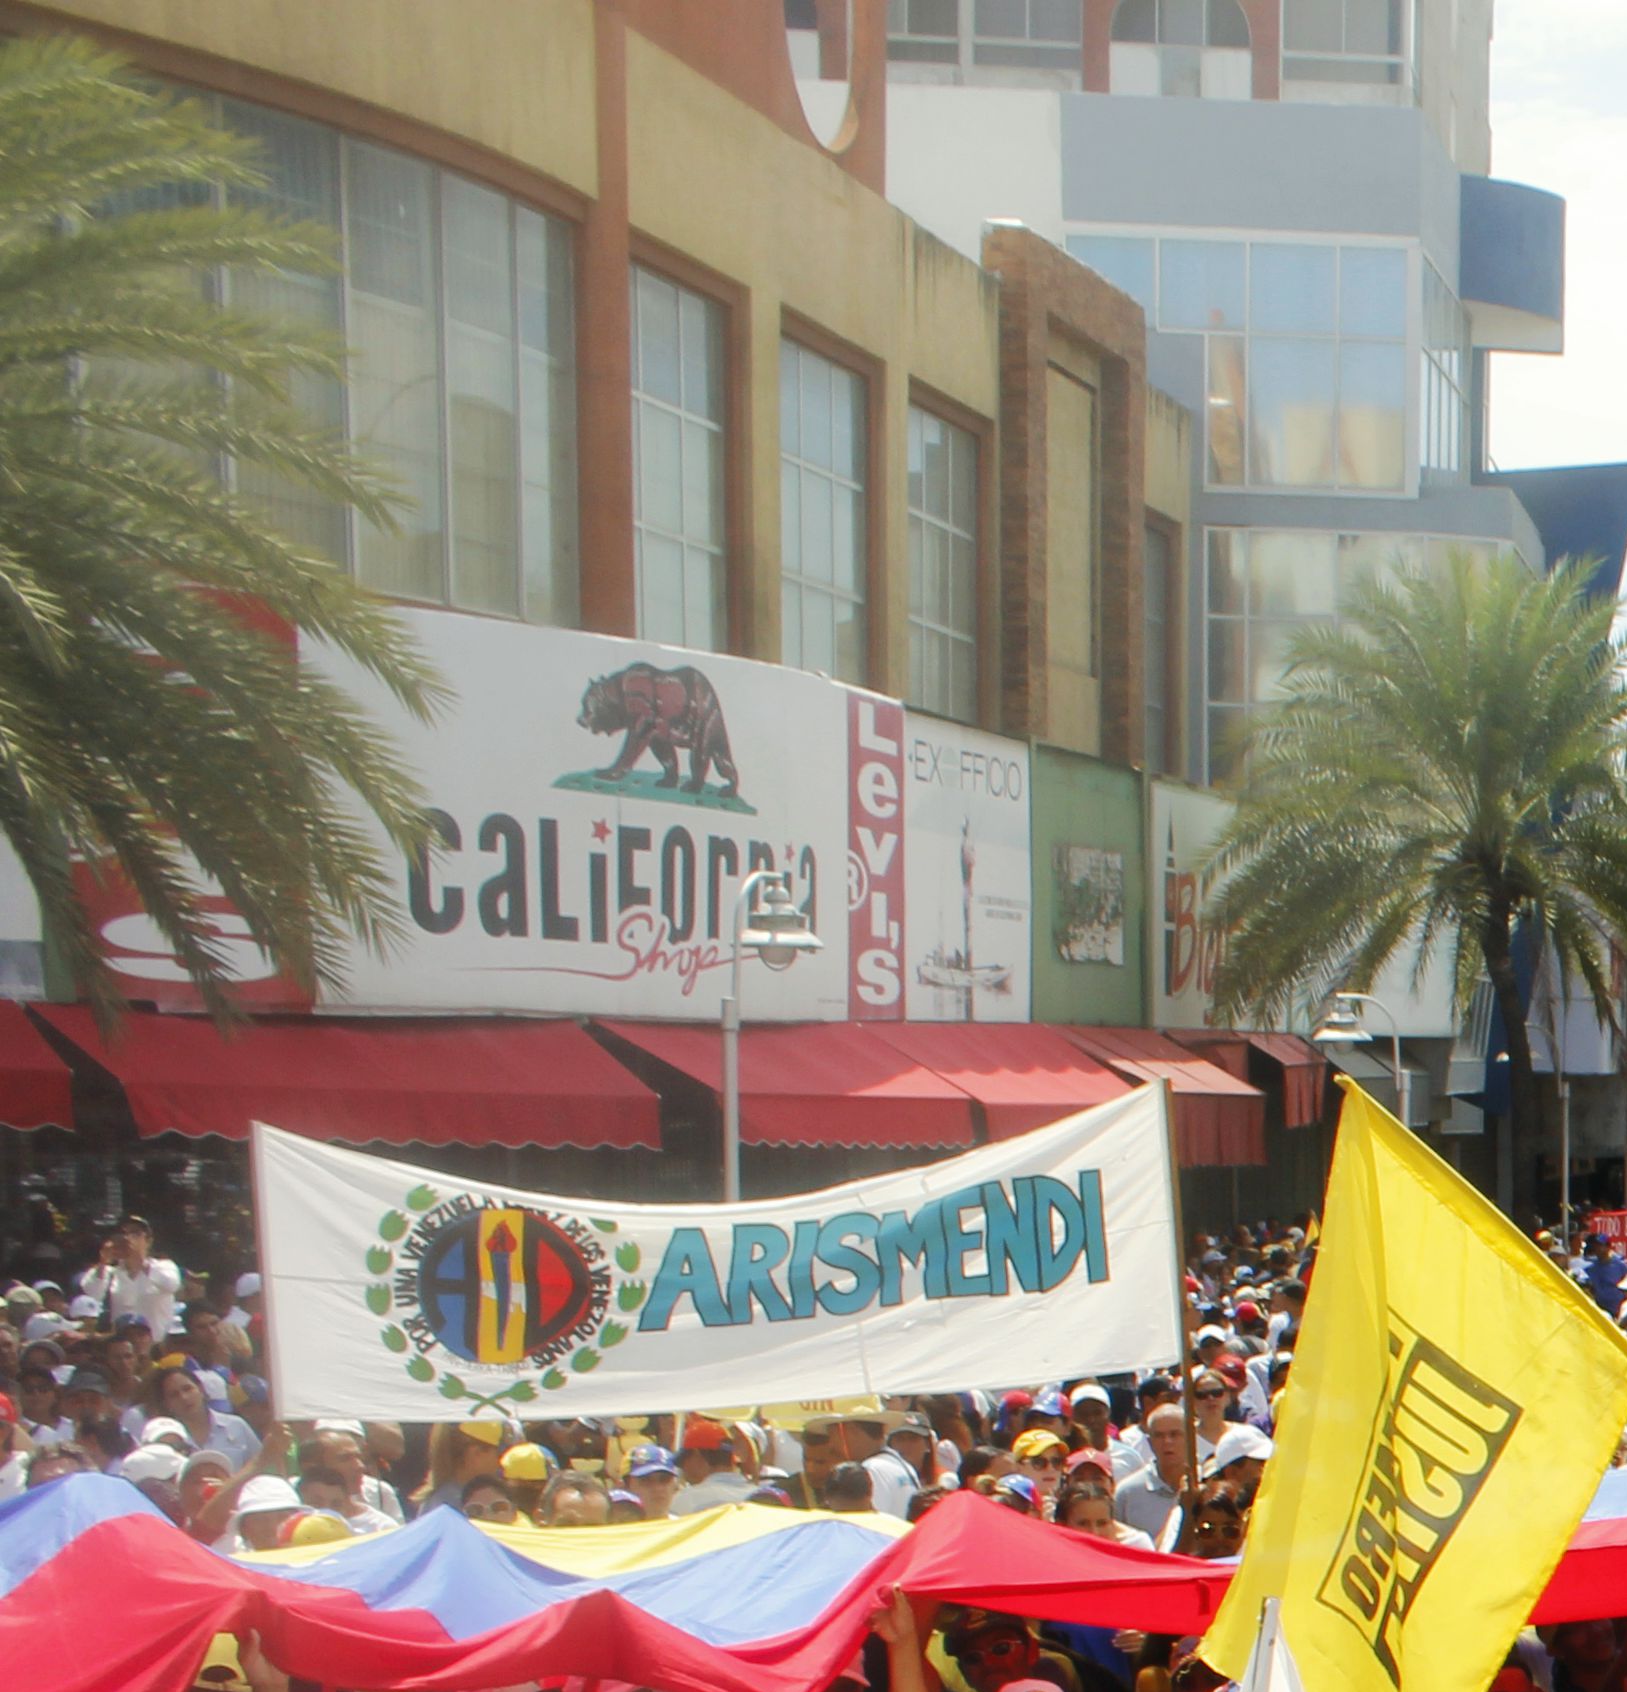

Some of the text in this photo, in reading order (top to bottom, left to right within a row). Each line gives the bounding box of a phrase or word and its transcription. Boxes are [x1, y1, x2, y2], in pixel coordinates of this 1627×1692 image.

[614, 911, 724, 997] Shop
[637, 1168, 1110, 1332] ARISMENDI
[393, 1267, 419, 1308] UNA
[402, 1314, 437, 1354] POR
